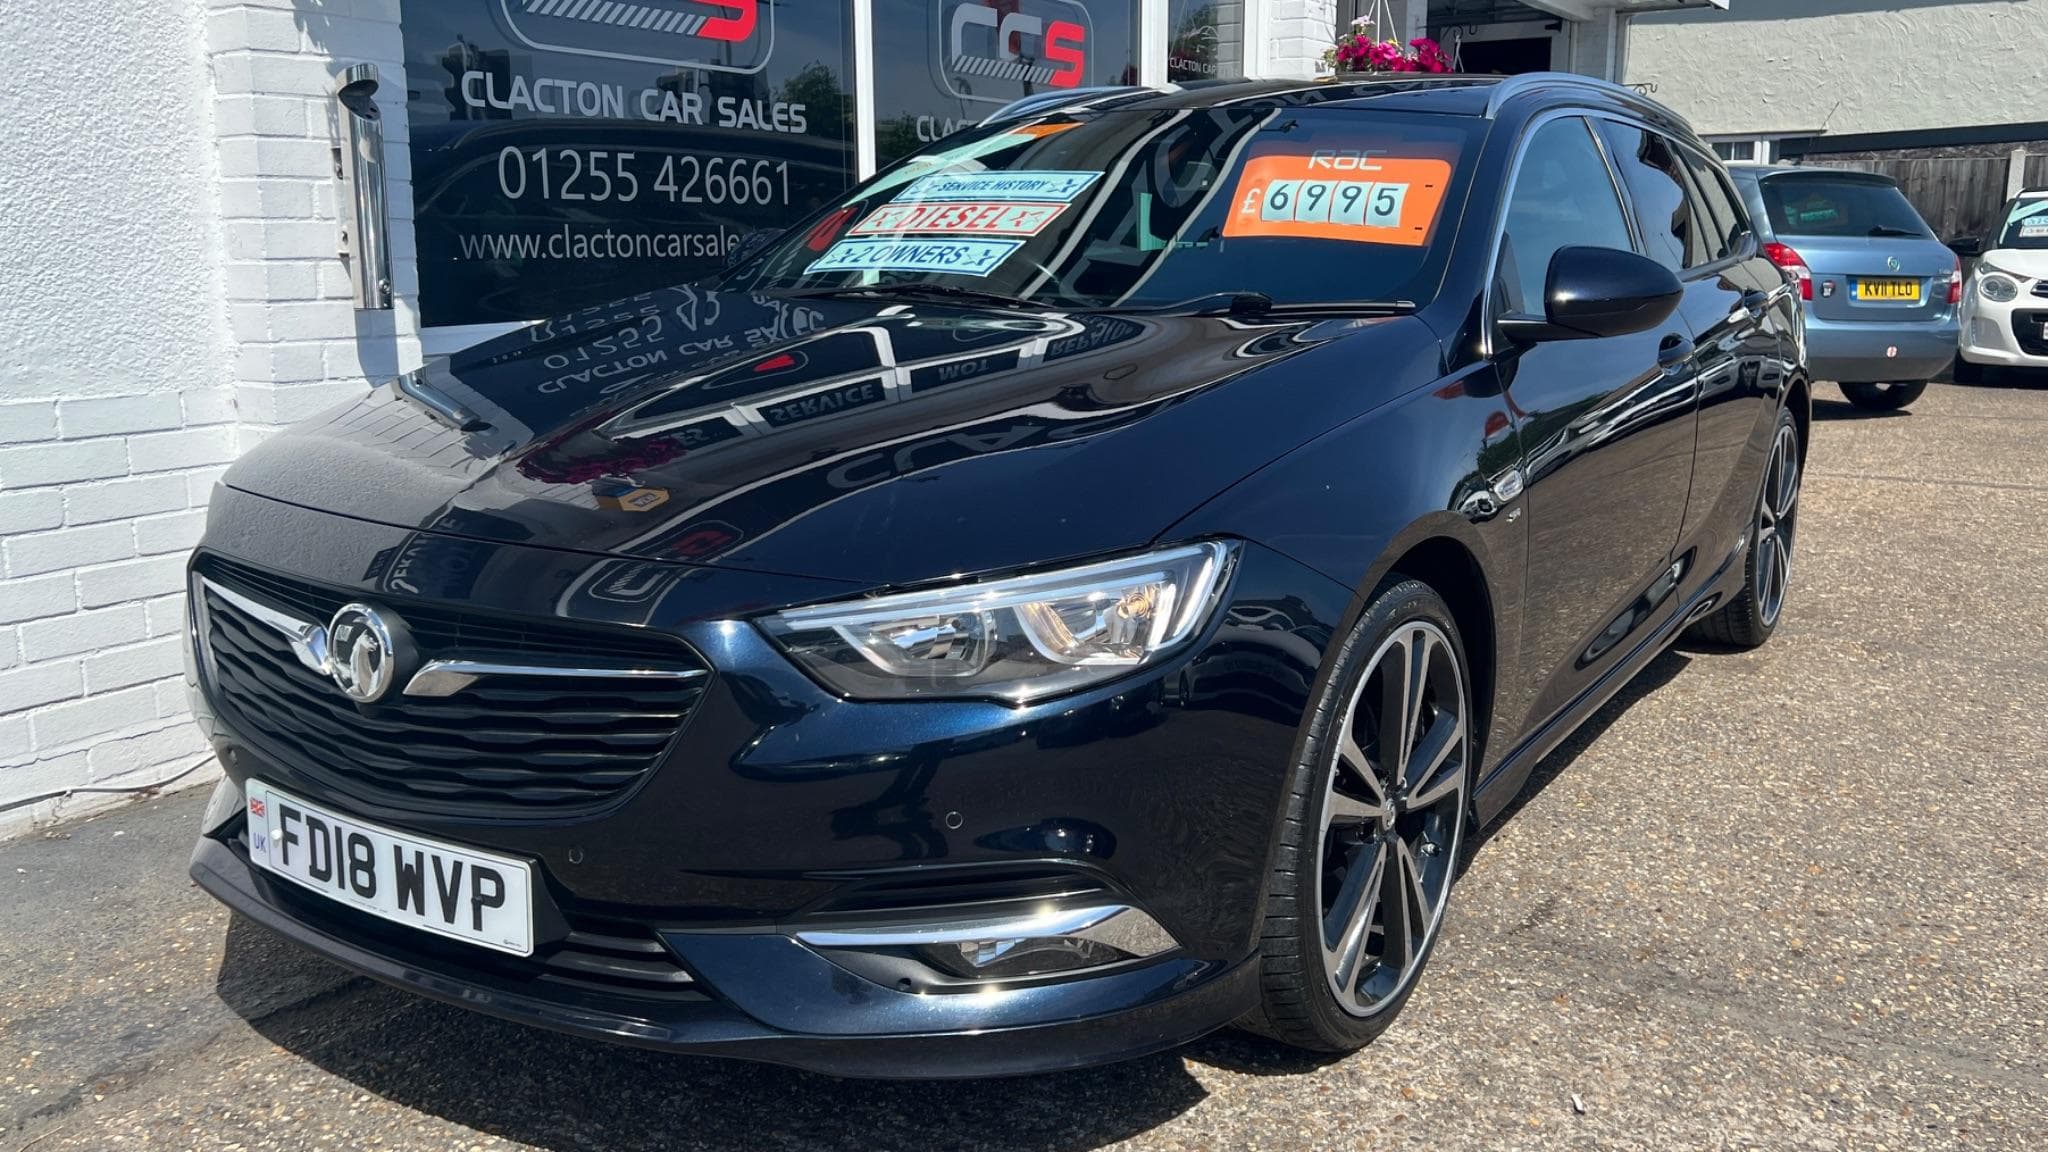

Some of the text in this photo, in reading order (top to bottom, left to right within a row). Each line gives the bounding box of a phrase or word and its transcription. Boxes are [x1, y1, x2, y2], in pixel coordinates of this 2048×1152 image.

[461, 70, 807, 134] CLACTON CAR SALES
[498, 146, 790, 205] 01255 426661
[938, 180, 1049, 192] SERVICE HISTORY
[901, 205, 1008, 230] DIESEL
[459, 224, 740, 260] www.clactoncarsale
[854, 246, 971, 265] 2 OWNERS
[253, 832, 267, 853] UK
[279, 803, 506, 932] FD18 WVP
